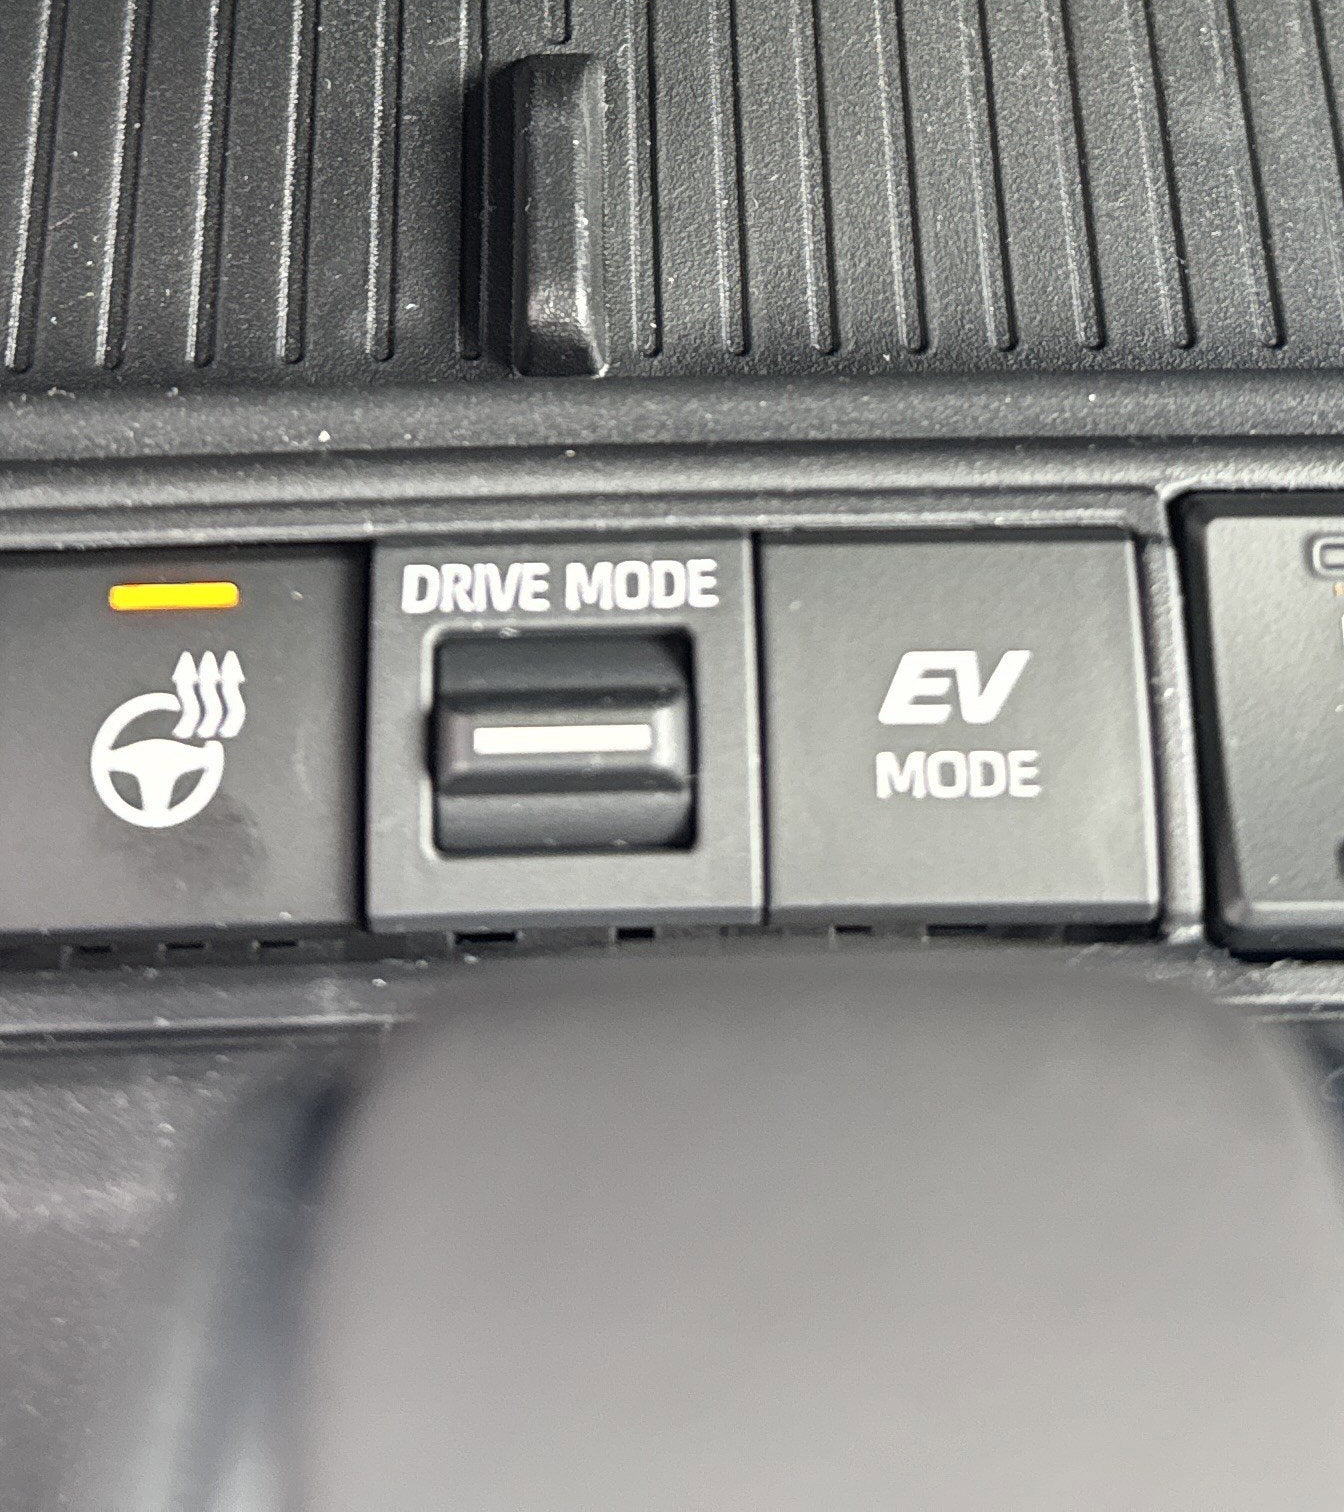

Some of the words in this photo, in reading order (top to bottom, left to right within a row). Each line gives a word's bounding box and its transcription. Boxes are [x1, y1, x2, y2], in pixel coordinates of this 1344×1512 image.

[400, 561, 551, 615] DRIVE
[563, 557, 720, 612] MODE
[877, 648, 1033, 726] EV
[874, 748, 1043, 800] MODE
